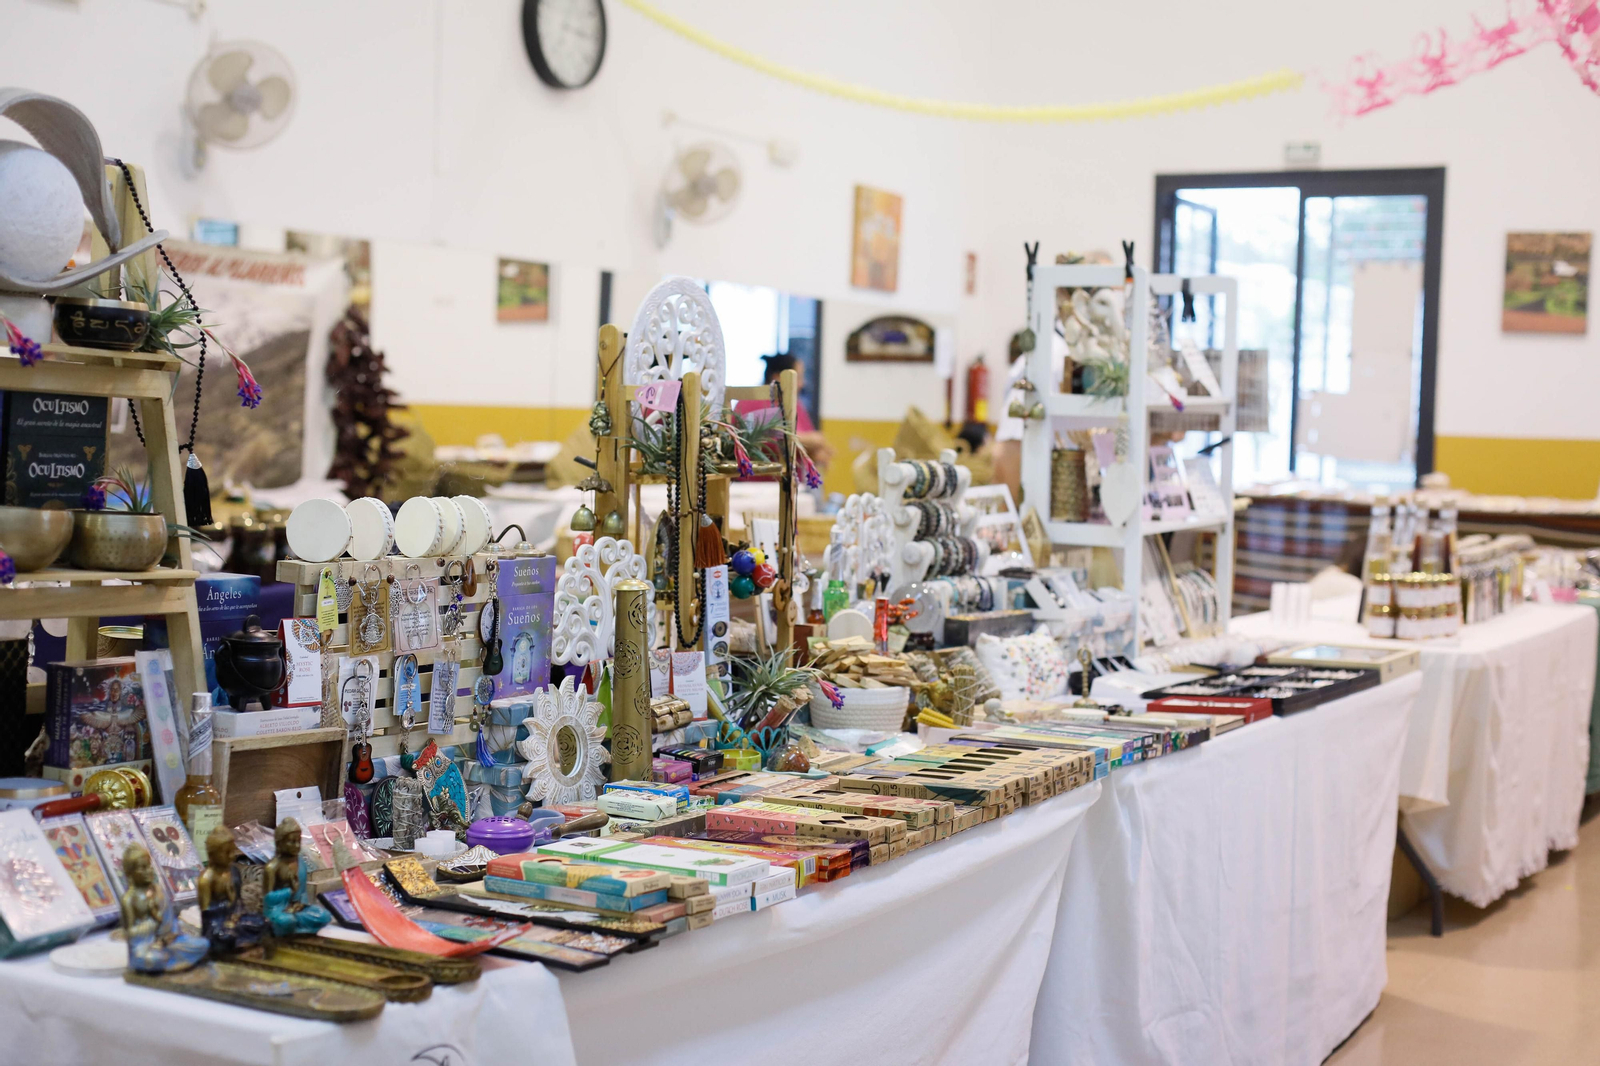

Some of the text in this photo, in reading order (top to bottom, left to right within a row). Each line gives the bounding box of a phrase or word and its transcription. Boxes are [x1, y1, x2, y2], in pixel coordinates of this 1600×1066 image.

[33, 398, 89, 415] OCULTISMO
[29, 462, 85, 478] OCULTISMO
[514, 566, 539, 577] Sueños
[206, 586, 242, 604] Ángeles
[507, 611, 541, 626] Sueños
[773, 890, 787, 901] MUSK
[719, 901, 748, 916] DUTCH ROSE
